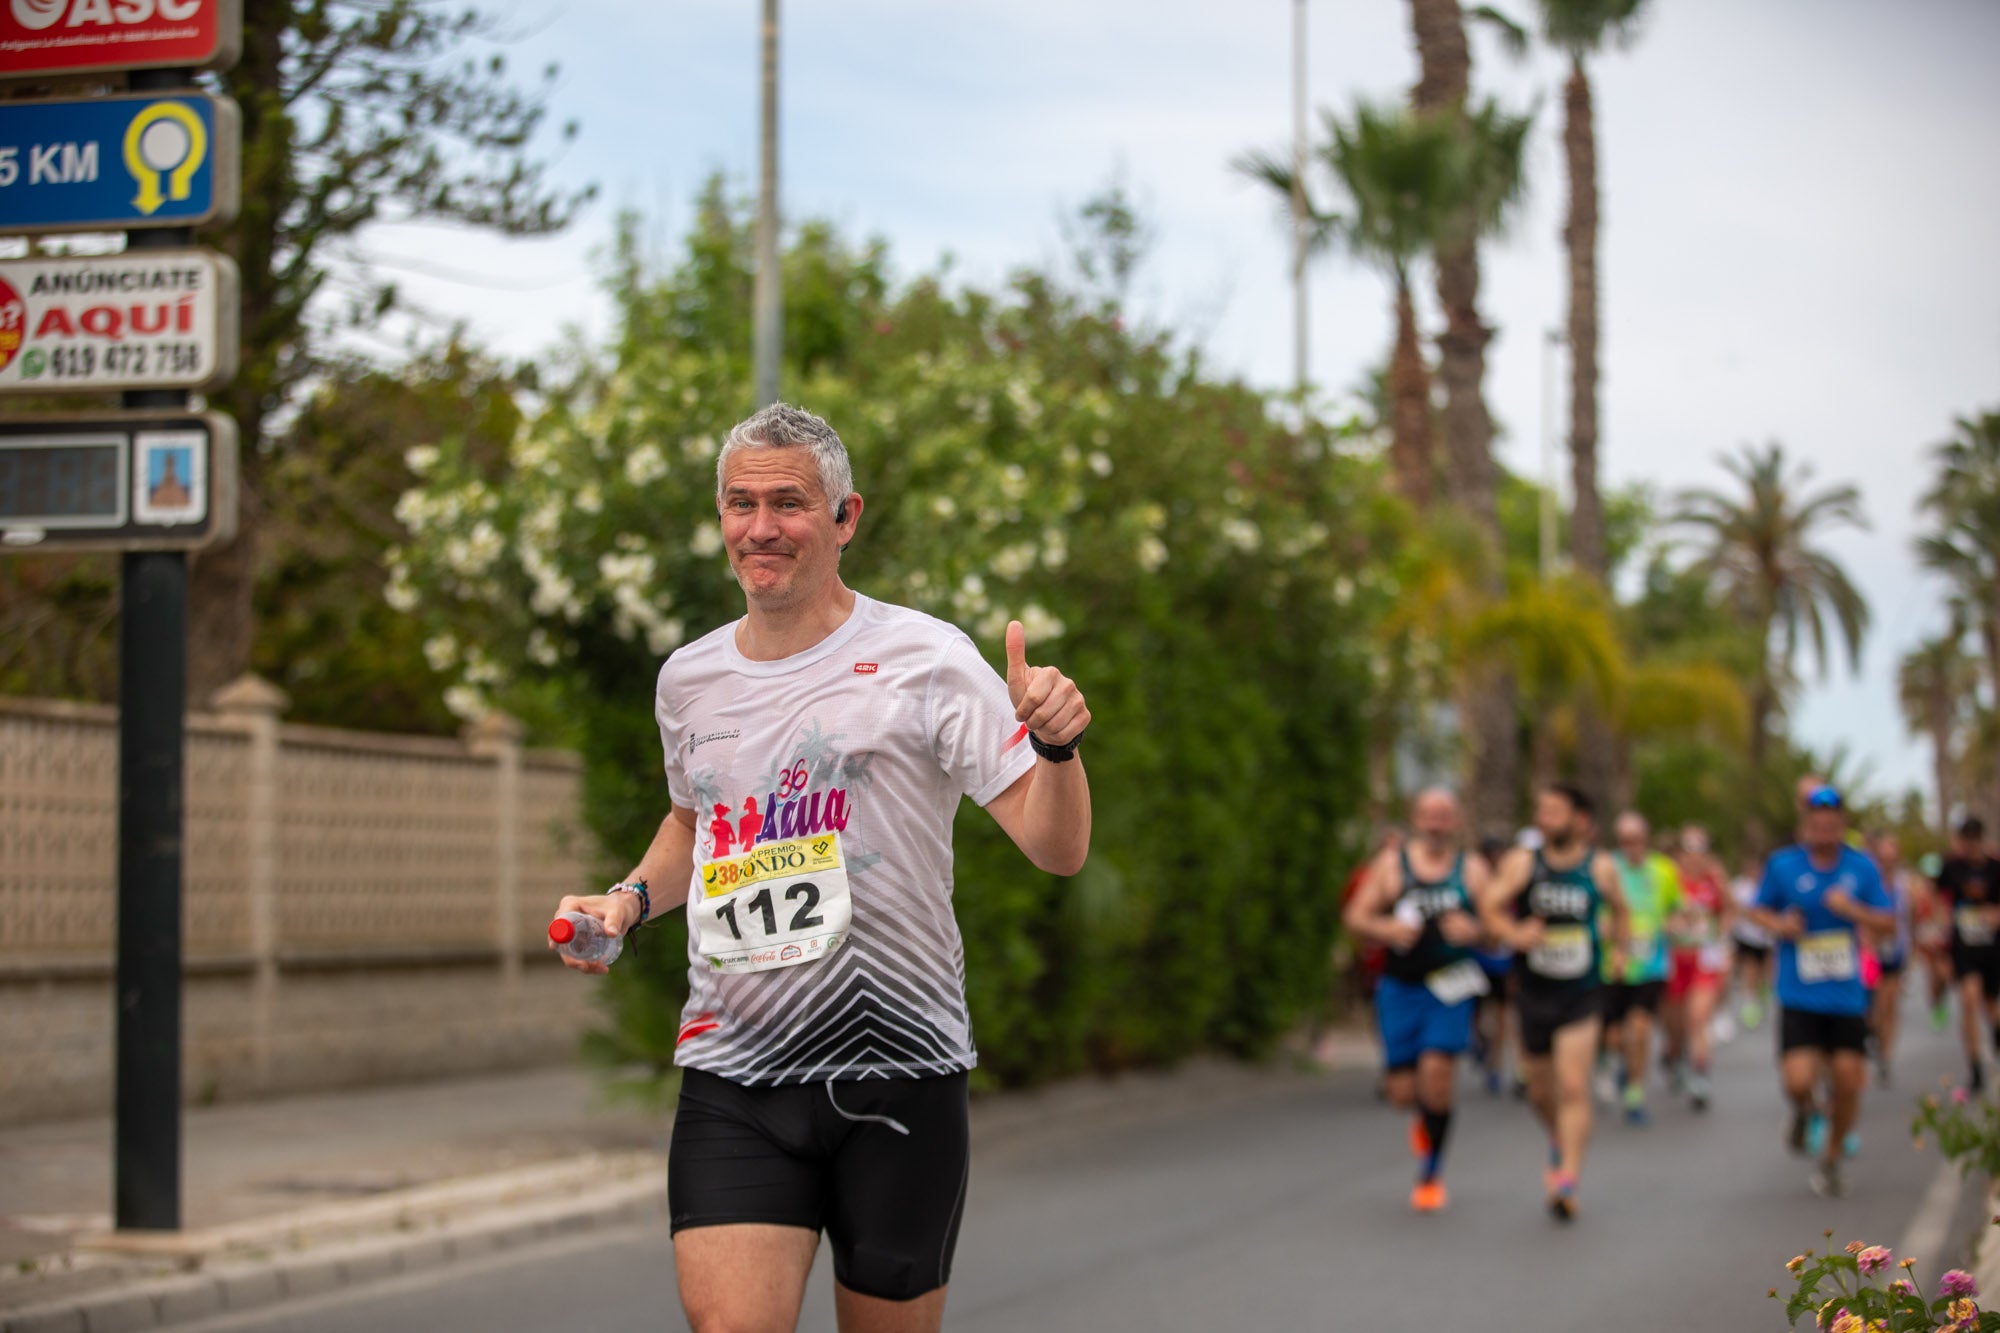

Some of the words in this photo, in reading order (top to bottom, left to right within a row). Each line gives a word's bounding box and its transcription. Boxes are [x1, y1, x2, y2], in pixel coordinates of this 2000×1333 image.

[28, 140, 100, 186] KM
[29, 266, 204, 296] ANÚNCIATE
[33, 292, 197, 342] AQUÍ
[777, 758, 808, 799] 36
[757, 844, 796, 858] PREMIO
[718, 864, 739, 885] 38
[716, 882, 824, 941] 112
